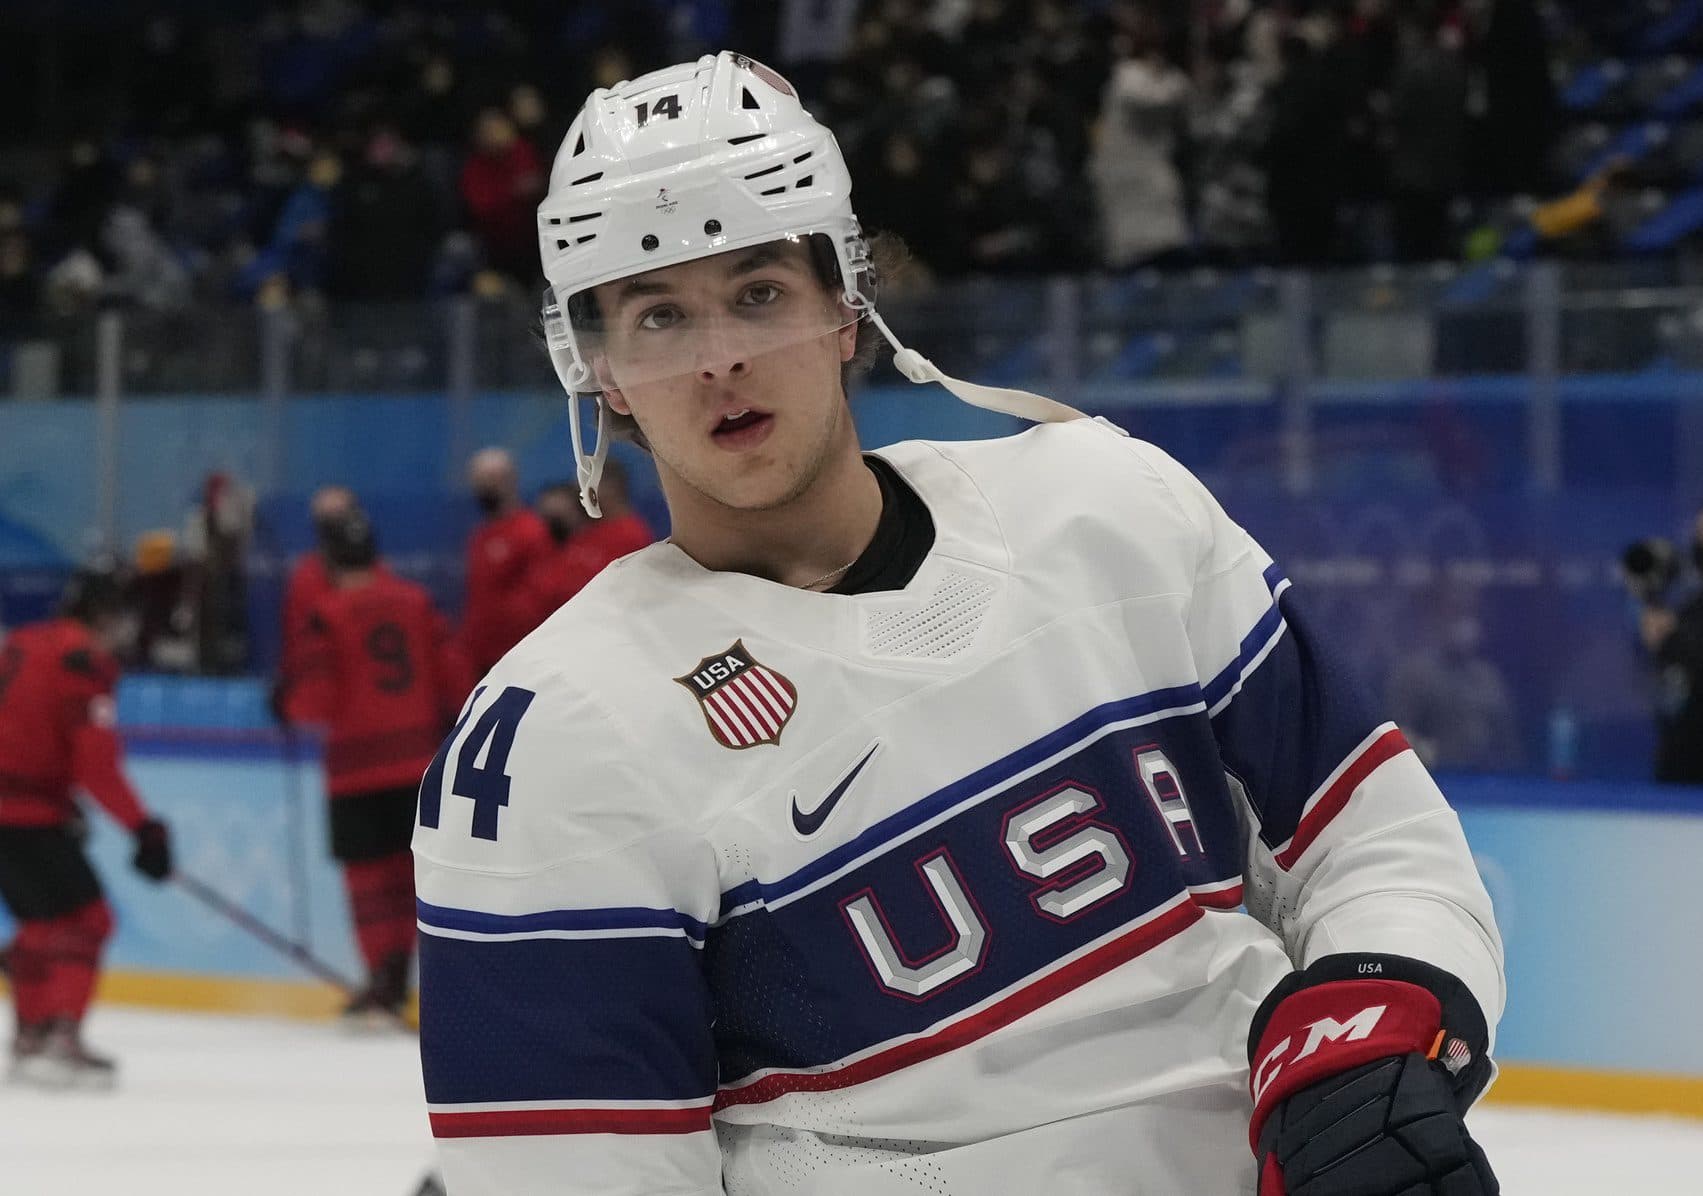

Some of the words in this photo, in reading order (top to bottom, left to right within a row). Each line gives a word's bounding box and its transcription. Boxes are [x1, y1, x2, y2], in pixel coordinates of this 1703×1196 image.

[634, 94, 682, 128] 14
[693, 655, 745, 689] USA
[838, 743, 1207, 1002] USA
[1357, 962, 1383, 974] USA
